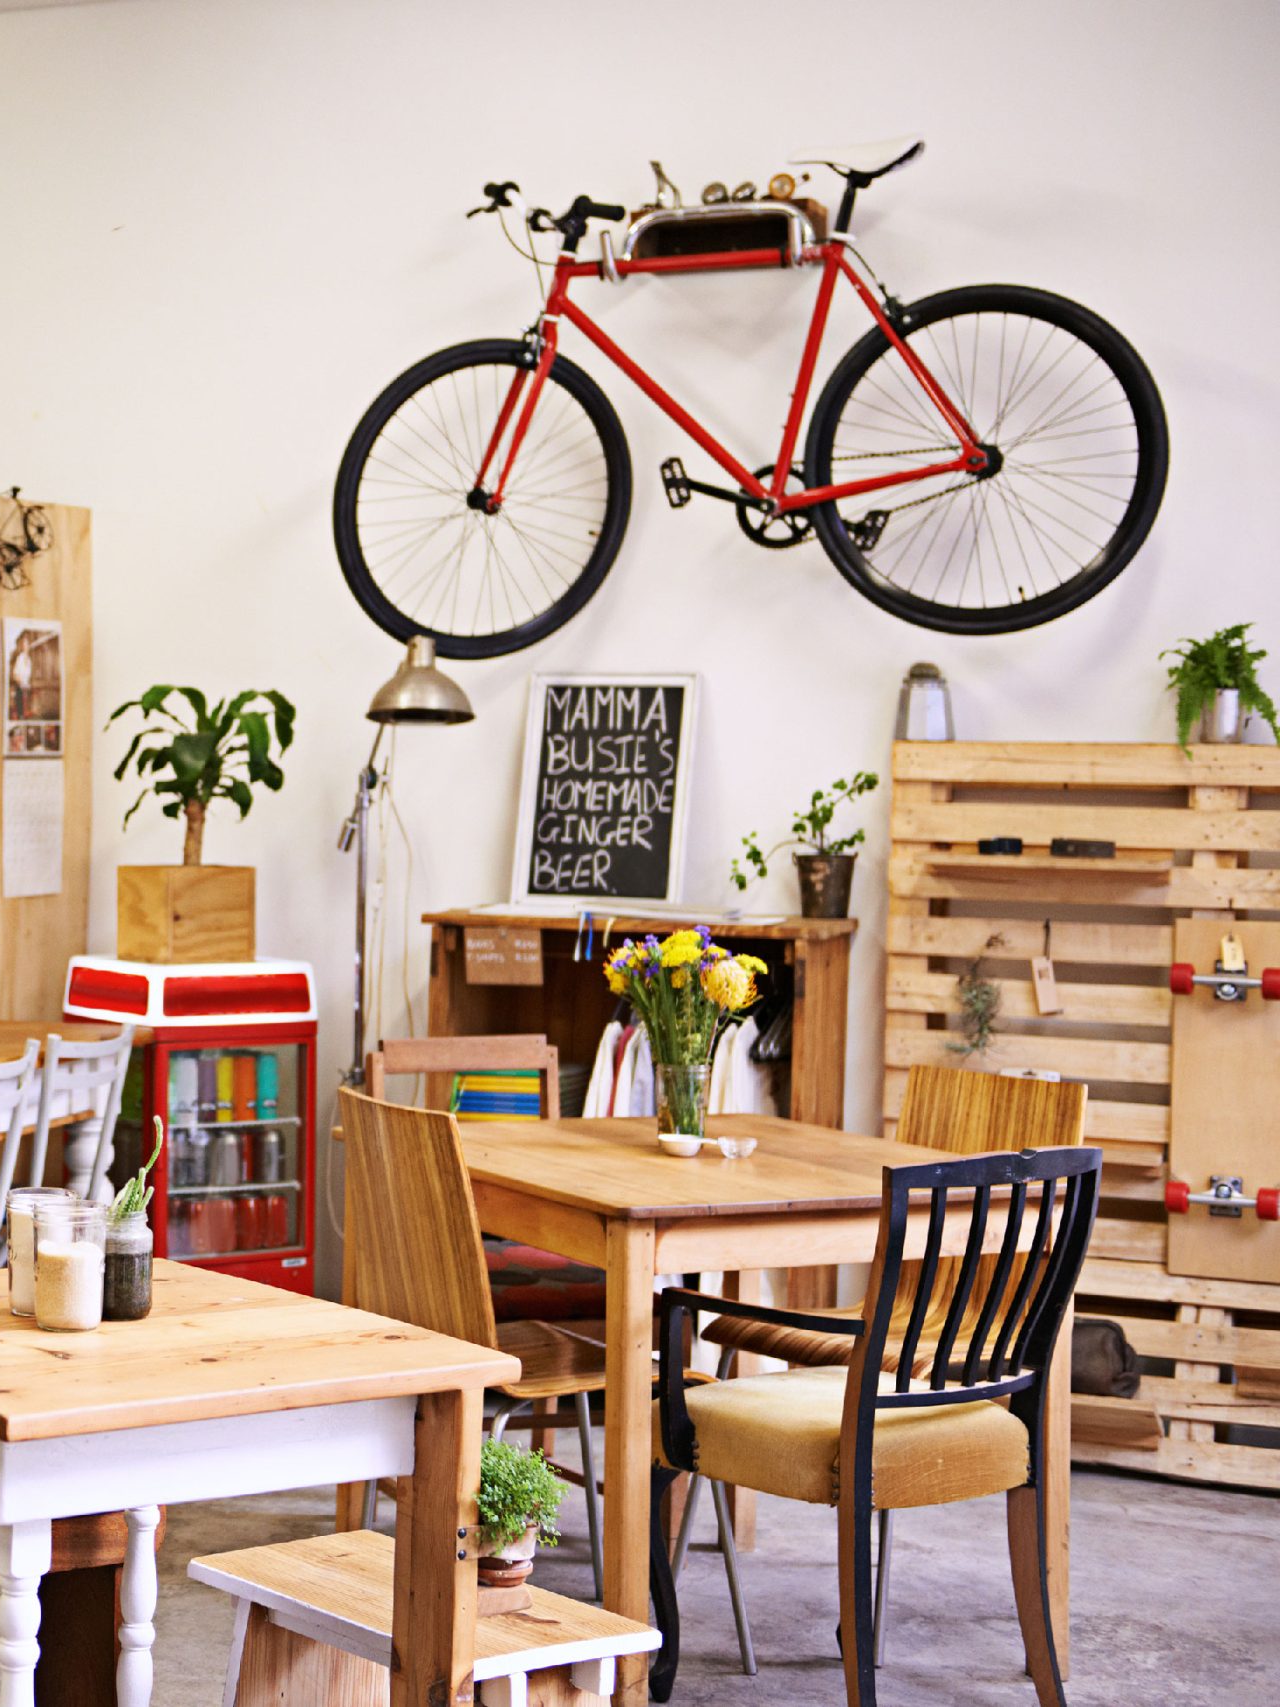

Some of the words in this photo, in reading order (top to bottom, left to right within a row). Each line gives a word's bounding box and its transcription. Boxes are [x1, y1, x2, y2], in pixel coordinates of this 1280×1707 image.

[546, 687, 668, 733] MAMMA
[542, 778, 673, 814] HOMEMADE
[537, 812, 653, 851] GINGER
